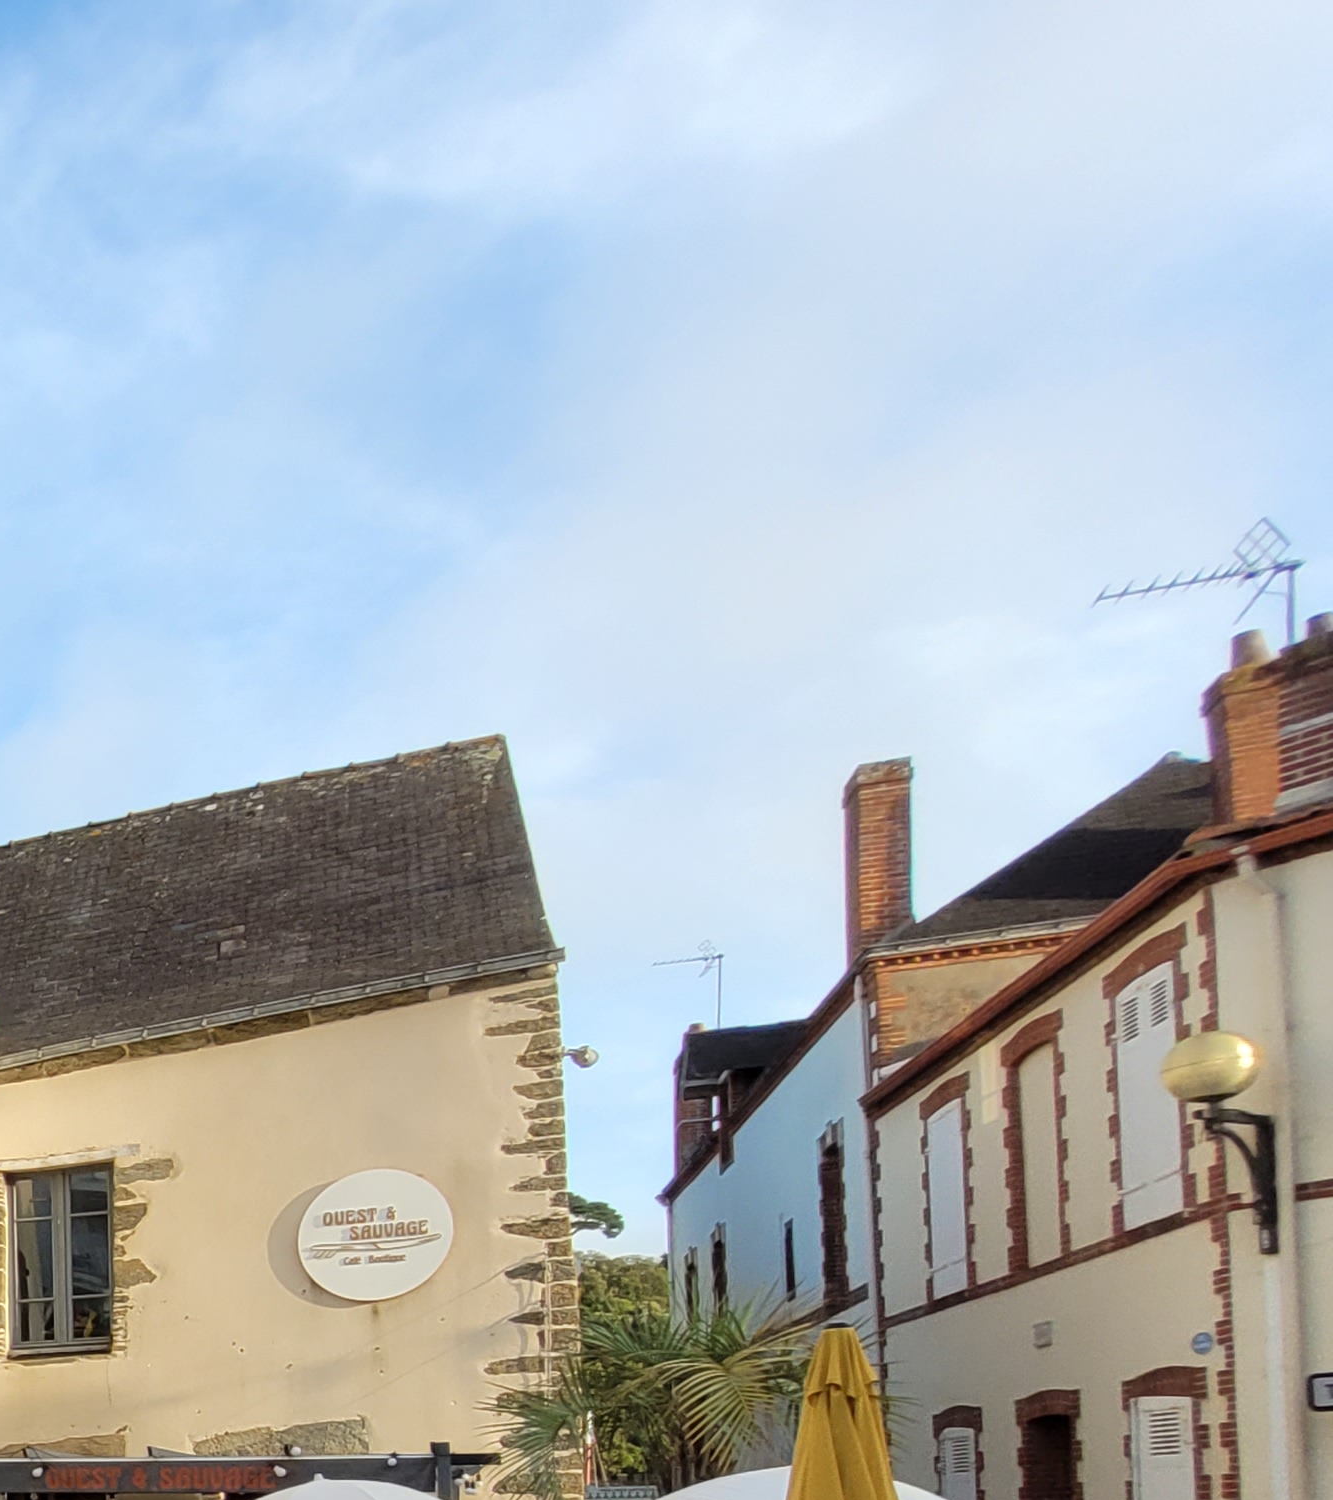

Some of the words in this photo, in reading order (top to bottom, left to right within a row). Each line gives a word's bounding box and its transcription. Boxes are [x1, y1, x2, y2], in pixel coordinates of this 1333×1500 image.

[322, 1207, 378, 1227] OUEST
[385, 1205, 397, 1221] &
[349, 1219, 429, 1241] SAUVAGE
[44, 1465, 123, 1490] OUEST
[131, 1465, 147, 1490] &
[158, 1464, 277, 1490] SAUVAGE
